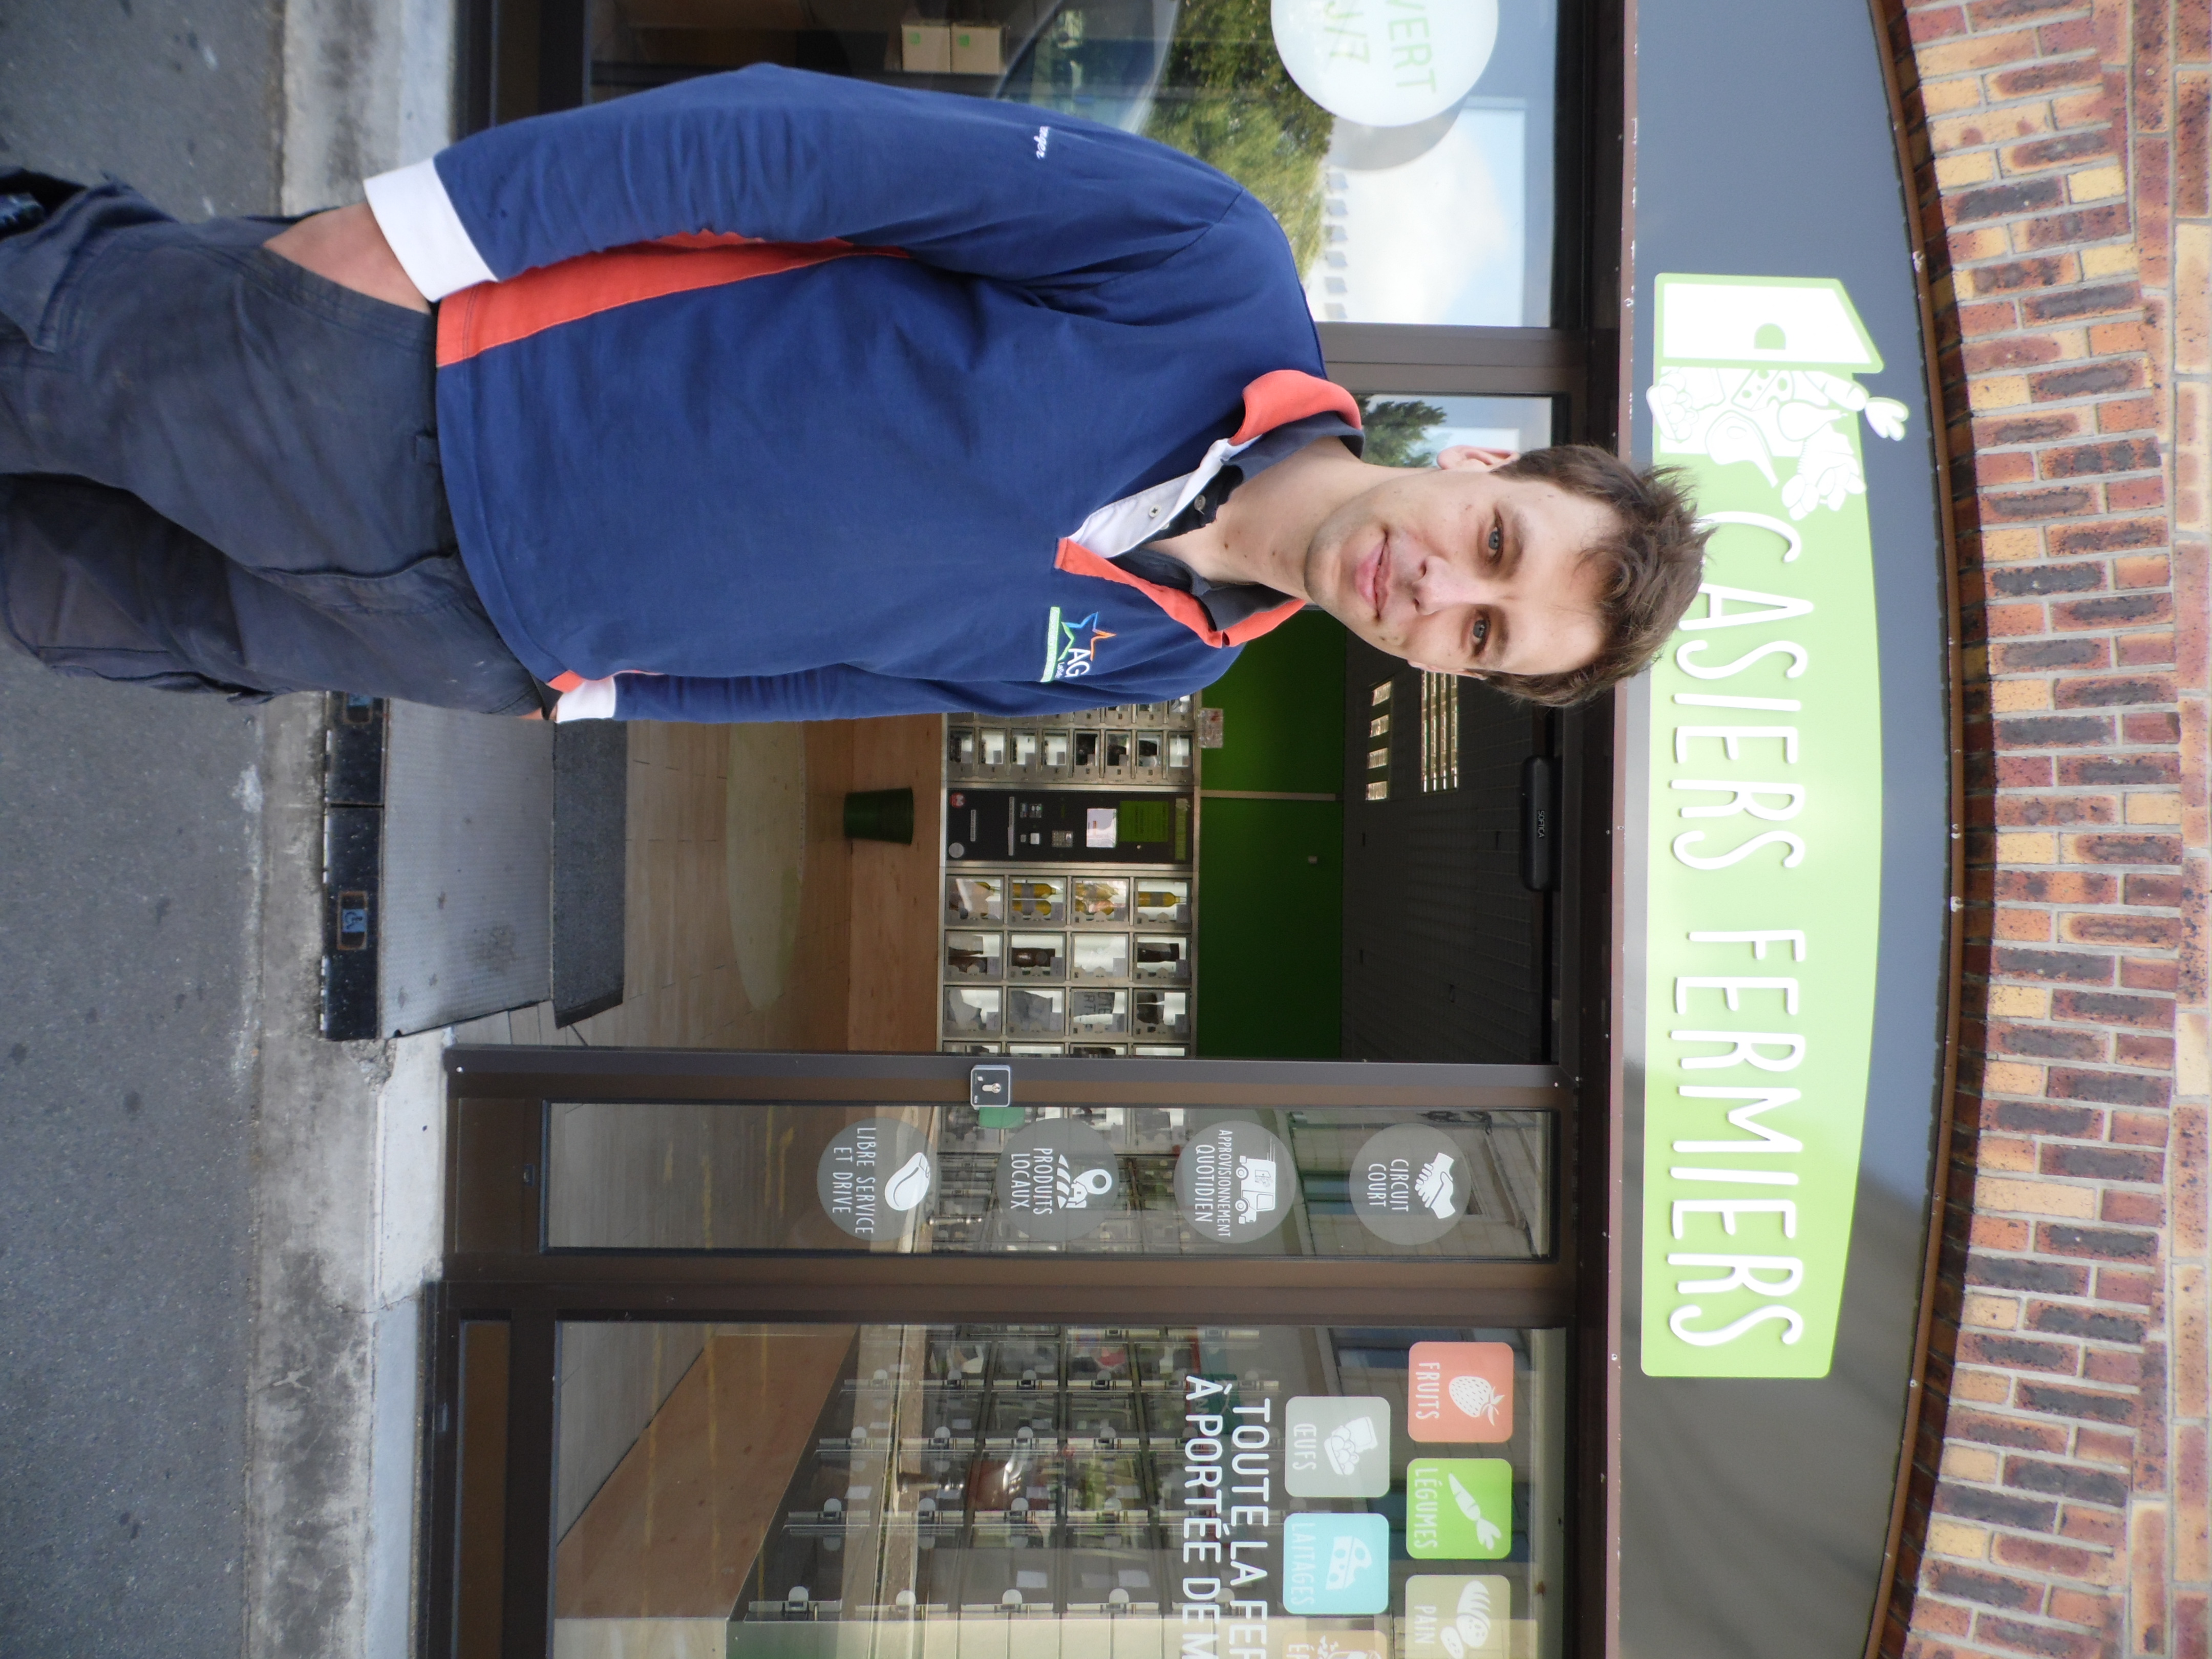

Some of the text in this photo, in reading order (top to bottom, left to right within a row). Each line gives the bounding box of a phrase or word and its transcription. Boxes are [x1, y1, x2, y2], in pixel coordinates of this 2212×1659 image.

[1064, 648, 1091, 678] AG
[1668, 511, 1814, 1346] CASIERS FERMIERS
[833, 1147, 853, 1214] ET DRIVE
[855, 1128, 877, 1233] LIBRE SERVICE
[1010, 1153, 1030, 1209] LOCAUX
[1032, 1147, 1053, 1215] PRODUITS
[1195, 1144, 1215, 1222] QUOTIDIEN
[1217, 1130, 1233, 1237] APPROVISIONNEMENT
[1366, 1163, 1387, 1207] COURT
[1390, 1159, 1409, 1213] CIRCUIT
[1185, 1375, 1232, 1400] À
[1415, 1362, 1440, 1419] FRUITS
[1230, 1398, 1270, 1527] TOUTE
[1292, 1423, 1316, 1471] ŒUFS
[1183, 1415, 1230, 1563] PORTÉE
[1414, 1467, 1442, 1548] LÉGUMES
[1229, 1541, 1268, 1586] LA
[1291, 1522, 1315, 1605] LAITAGES
[1182, 1578, 1220, 1624] DE
[1414, 1606, 1437, 1645] PAIN
